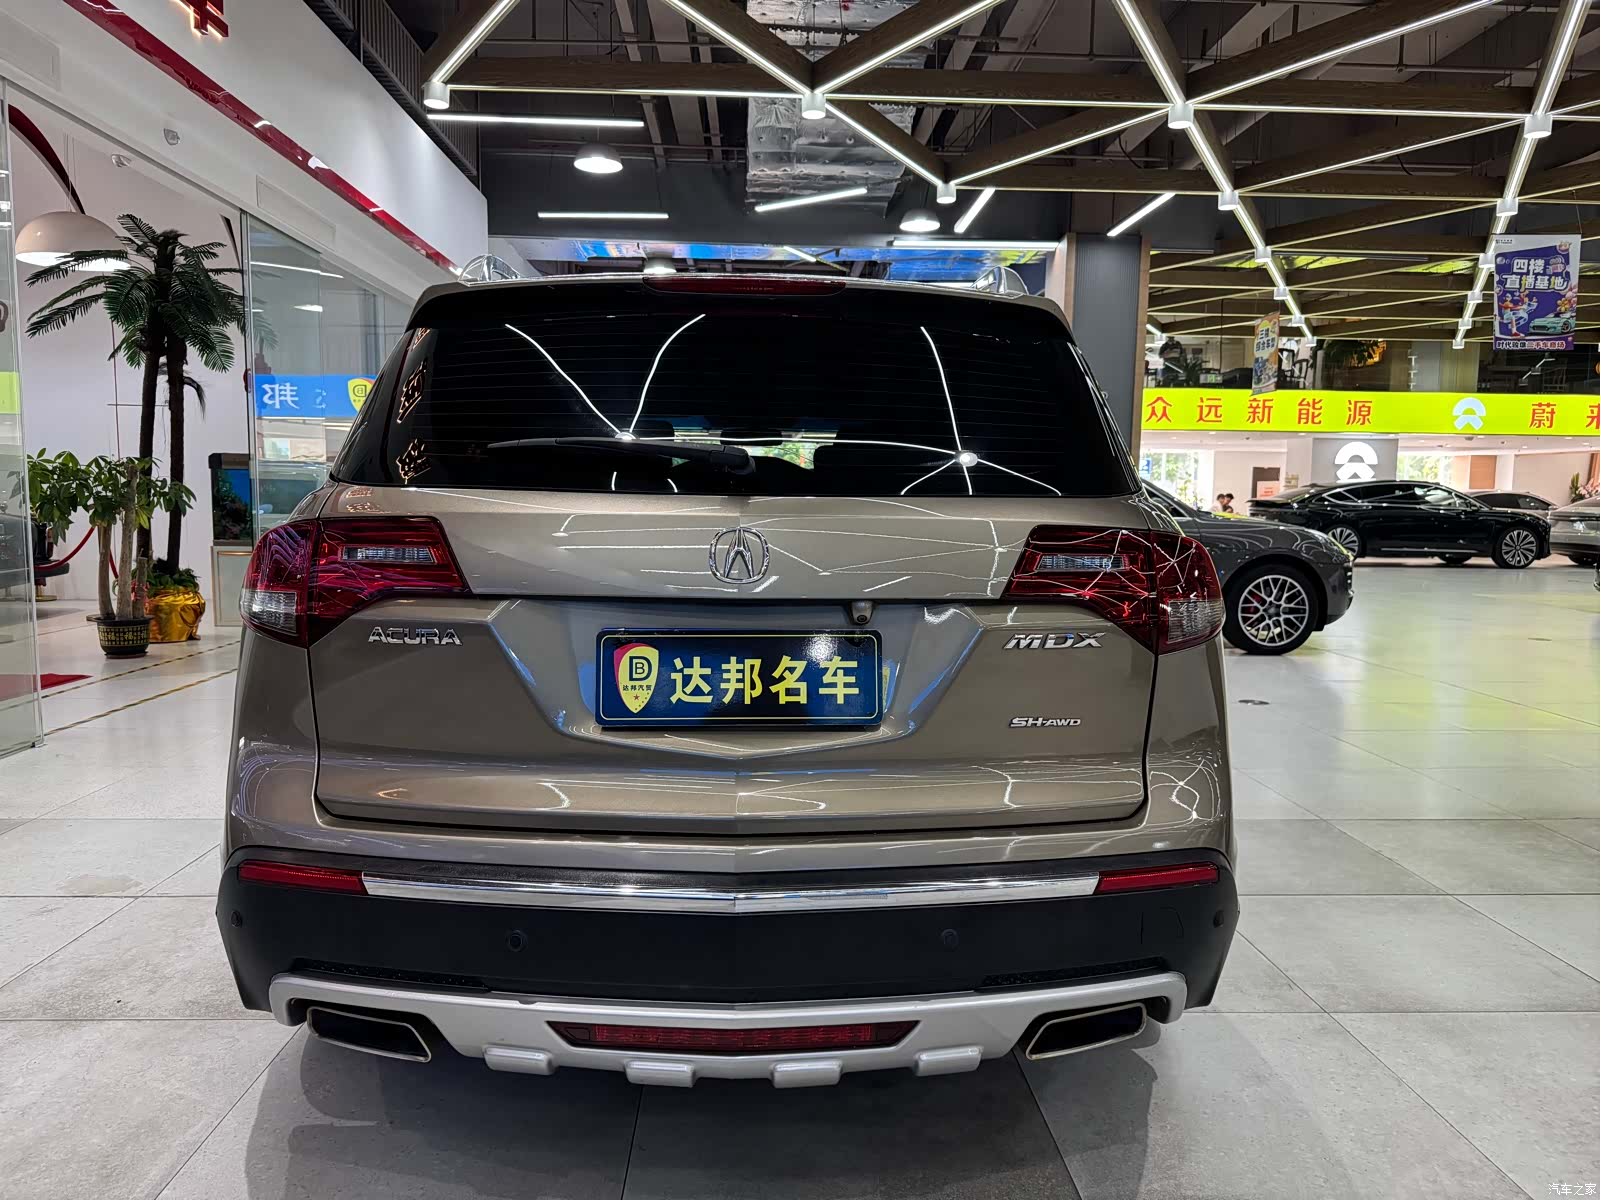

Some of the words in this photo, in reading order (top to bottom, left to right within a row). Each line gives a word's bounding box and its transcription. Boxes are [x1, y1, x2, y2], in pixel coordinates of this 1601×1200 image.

[1513, 258, 1545, 275] 四楼
[1503, 275, 1568, 290] 直播基地
[1146, 396, 1372, 426] 众远新能源
[367, 626, 462, 646] ACURA
[1003, 632, 1107, 649] MDX
[669, 655, 860, 705] 达邦名车
[1010, 717, 1081, 727] SH-AWD
